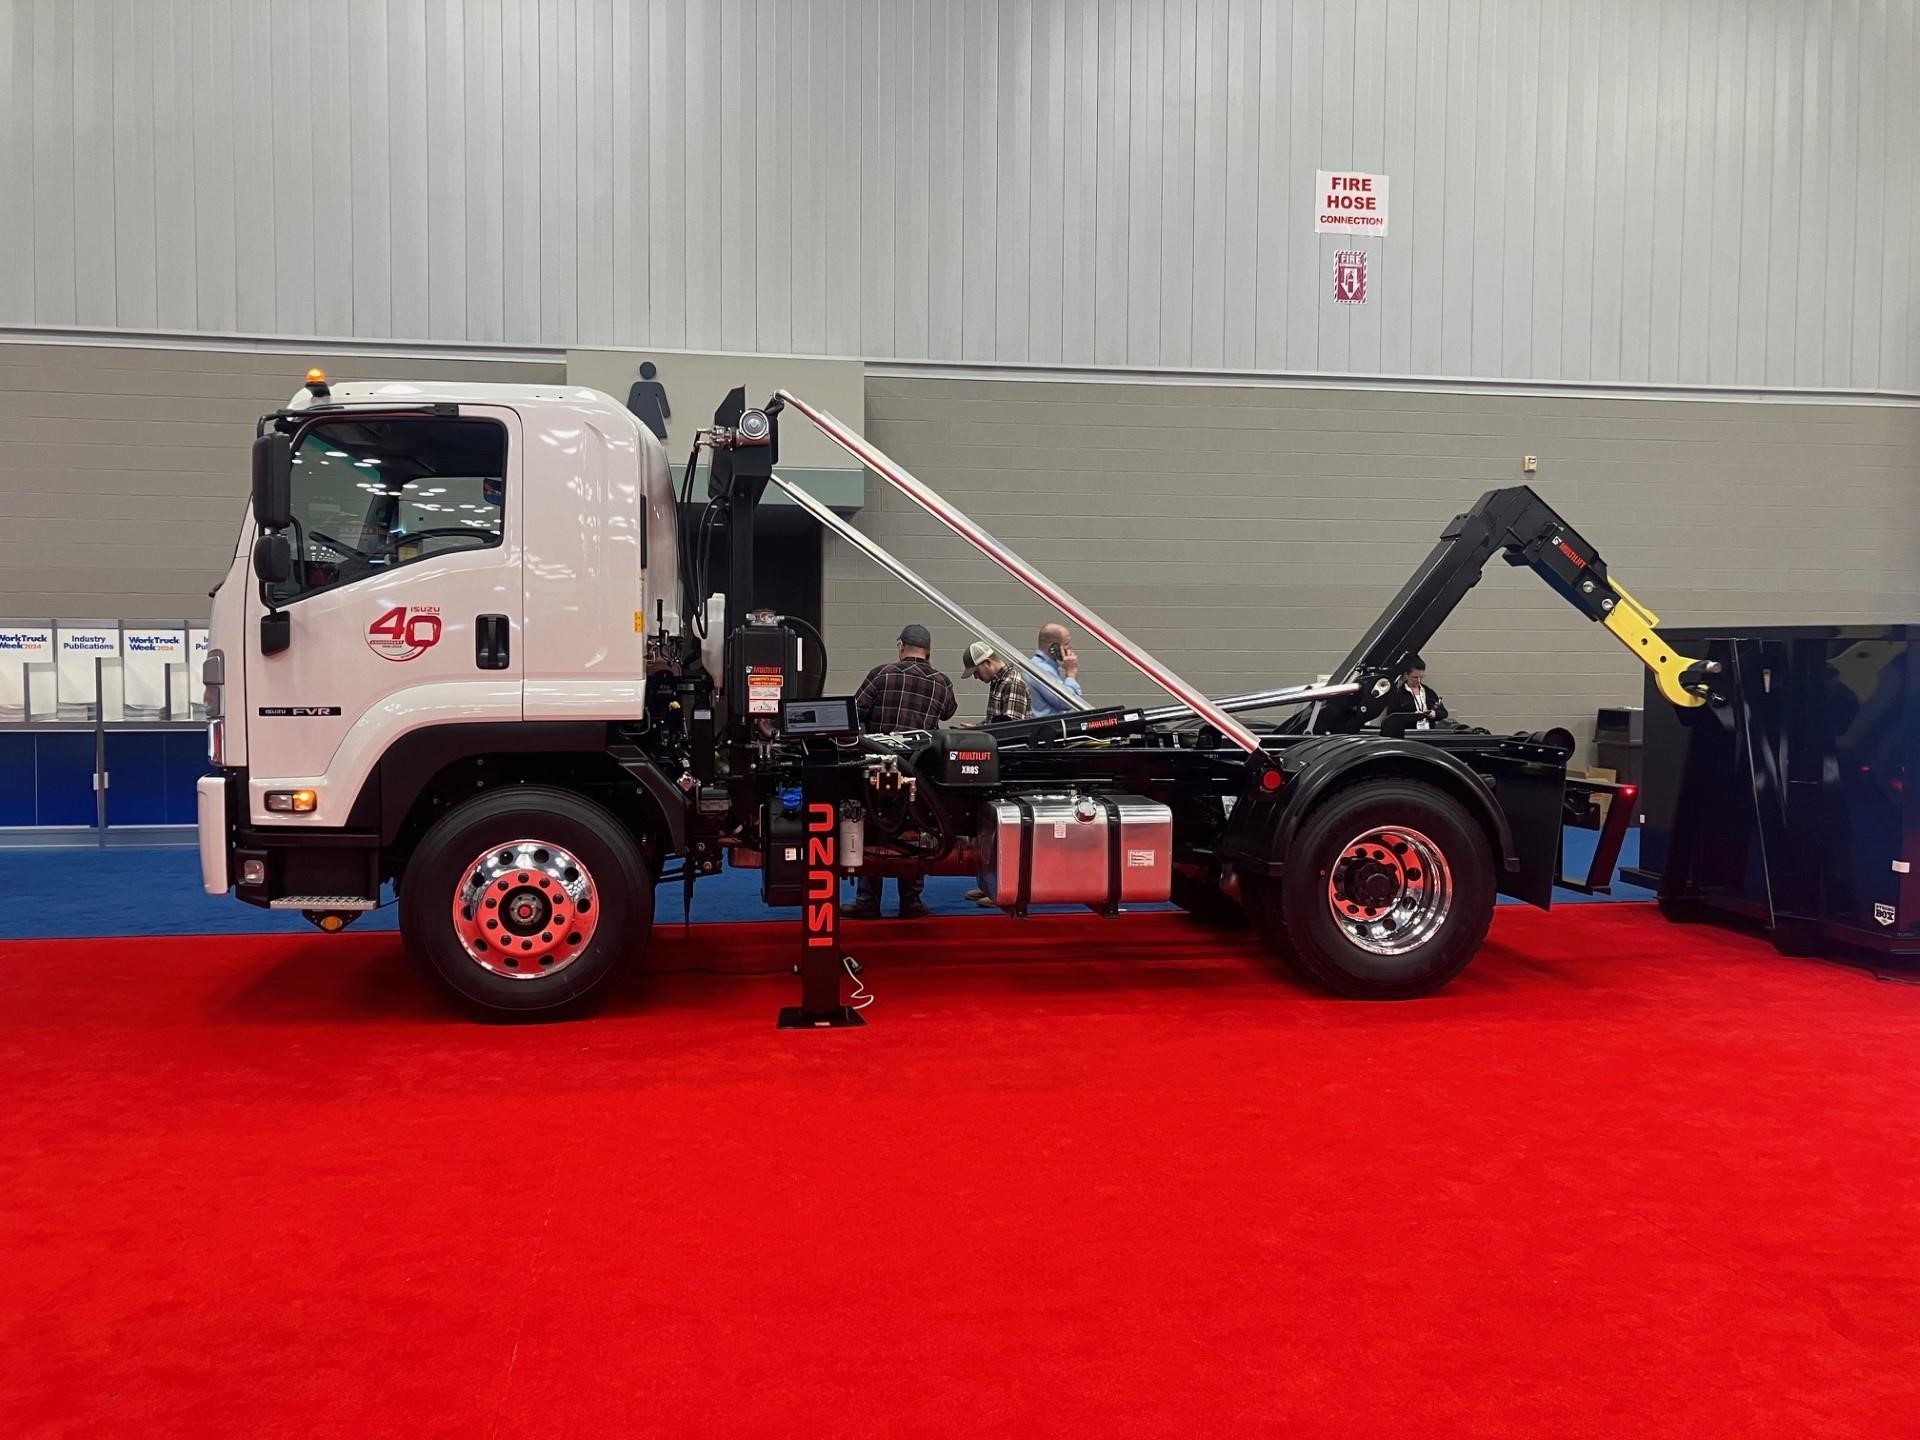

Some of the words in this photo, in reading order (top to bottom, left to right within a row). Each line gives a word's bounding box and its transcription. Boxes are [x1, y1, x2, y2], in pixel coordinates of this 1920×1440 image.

[1331, 176, 1372, 192] FIRE
[1327, 195, 1377, 210] HOSE
[1320, 215, 1383, 226] CONNECTION
[1341, 254, 1362, 265] FIRE
[369, 606, 442, 648] 40
[71, 635, 106, 644] Industry
[63, 642, 114, 650] Publications
[959, 751, 992, 760] MULTILIFT
[809, 803, 834, 946] ISUZU
[1876, 909, 1894, 921] BOX
